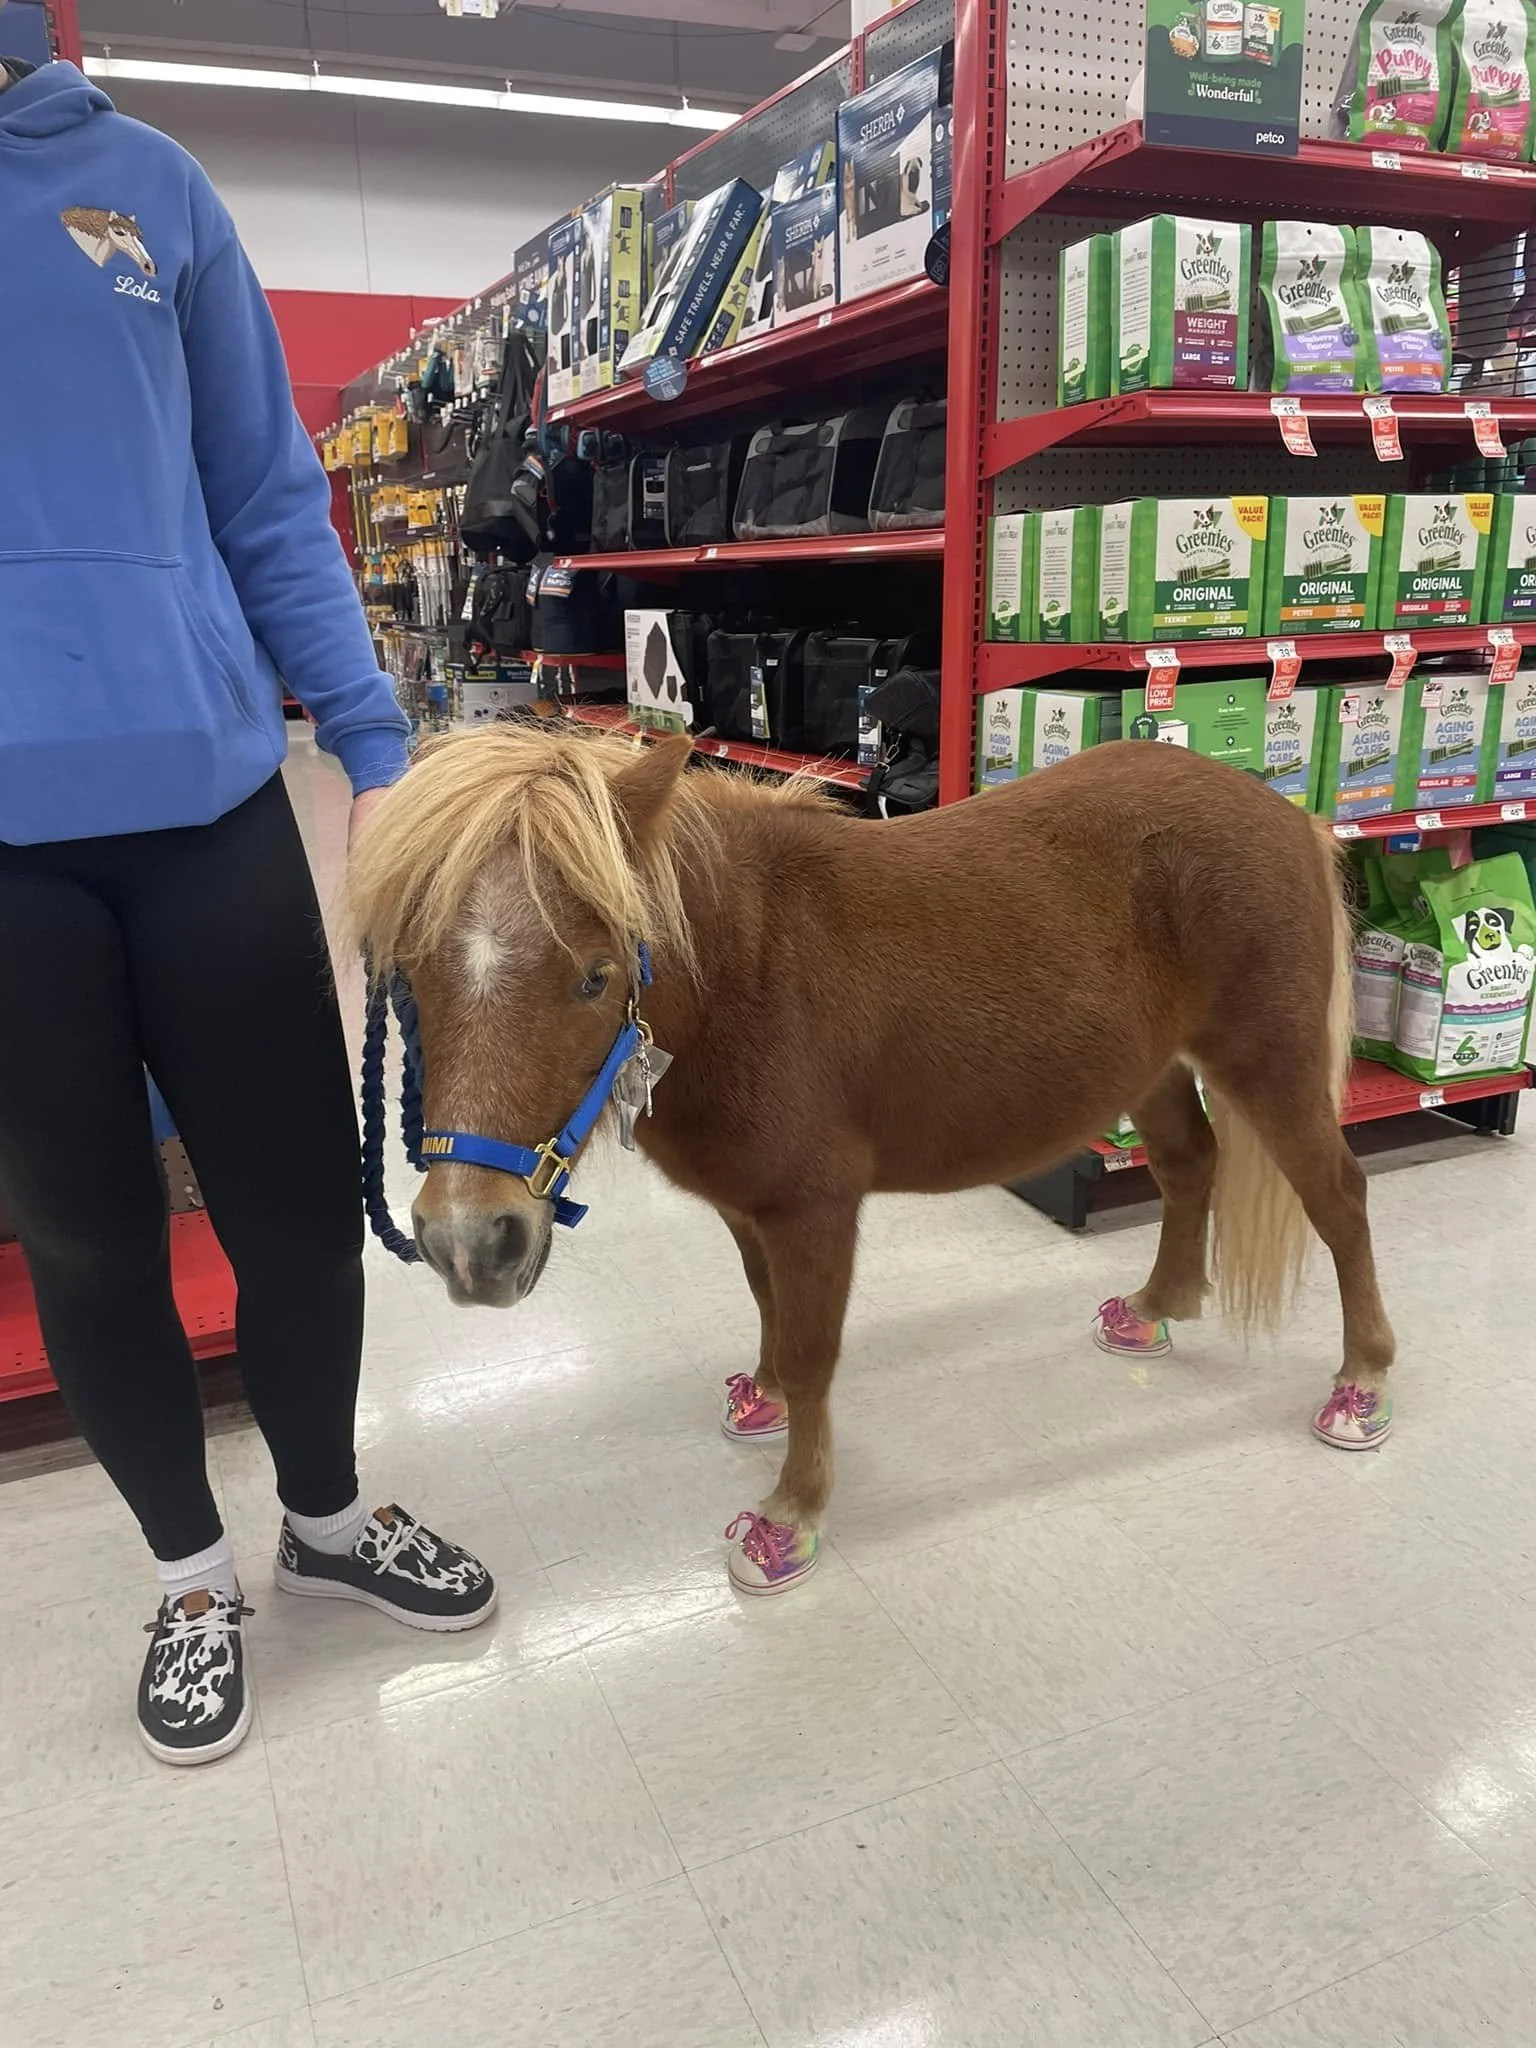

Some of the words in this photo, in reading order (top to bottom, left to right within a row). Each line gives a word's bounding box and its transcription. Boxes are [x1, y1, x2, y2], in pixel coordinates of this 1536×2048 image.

[1383, 22, 1426, 46] Greenies
[1473, 38, 1513, 62] Greenies
[1376, 49, 1432, 80] Puppy
[1189, 71, 1237, 87] Well-being
[1238, 78, 1262, 88] made
[1471, 64, 1524, 89] Puppy
[1196, 83, 1254, 103] Wonderful
[859, 109, 896, 145] SHERPA
[1256, 131, 1285, 144] petco
[785, 218, 814, 243] SHERPA
[1180, 257, 1233, 284] Greenies
[113, 275, 161, 303] Lola
[675, 316, 693, 344] SAFE
[687, 271, 714, 317] TRAVELS.
[710, 240, 729, 270] NEAR
[725, 230, 734, 241] &
[1278, 279, 1334, 305] Greenies
[1376, 284, 1423, 308] Greenies
[1187, 317, 1228, 330] WEIGHT
[1238, 506, 1264, 514] VALUE
[1242, 515, 1264, 523] PACK!
[1176, 529, 1234, 554] Greenies
[1303, 525, 1354, 549] Greenies
[1418, 523, 1465, 546] Greenies
[1300, 581, 1354, 595] ORIGINAL
[1412, 577, 1462, 591] ORIGINAL
[1173, 586, 1234, 602] ORIGINAL
[1228, 626, 1244, 636] 130
[1349, 619, 1361, 628] 60
[1272, 687, 1291, 696] PRICE
[1274, 680, 1290, 688] LOW
[1150, 689, 1168, 697] LOW
[1150, 697, 1172, 706] PRICE
[1440, 702, 1474, 718] Greenies
[990, 714, 1011, 728] Greenies
[1267, 719, 1301, 735] Greenies
[1435, 721, 1474, 733] AGING
[990, 733, 1011, 745] AGING
[1043, 723, 1071, 740] Greenies
[1352, 731, 1391, 746] AGING
[1438, 733, 1468, 745] CARE
[991, 745, 1007, 755] CARE
[1043, 744, 1070, 757] AGING
[1266, 739, 1300, 752] AGING
[1354, 743, 1385, 757] CARE
[1268, 752, 1294, 763] CARE
[1466, 960, 1529, 990] Greenies
[1456, 1034, 1477, 1066] 6
